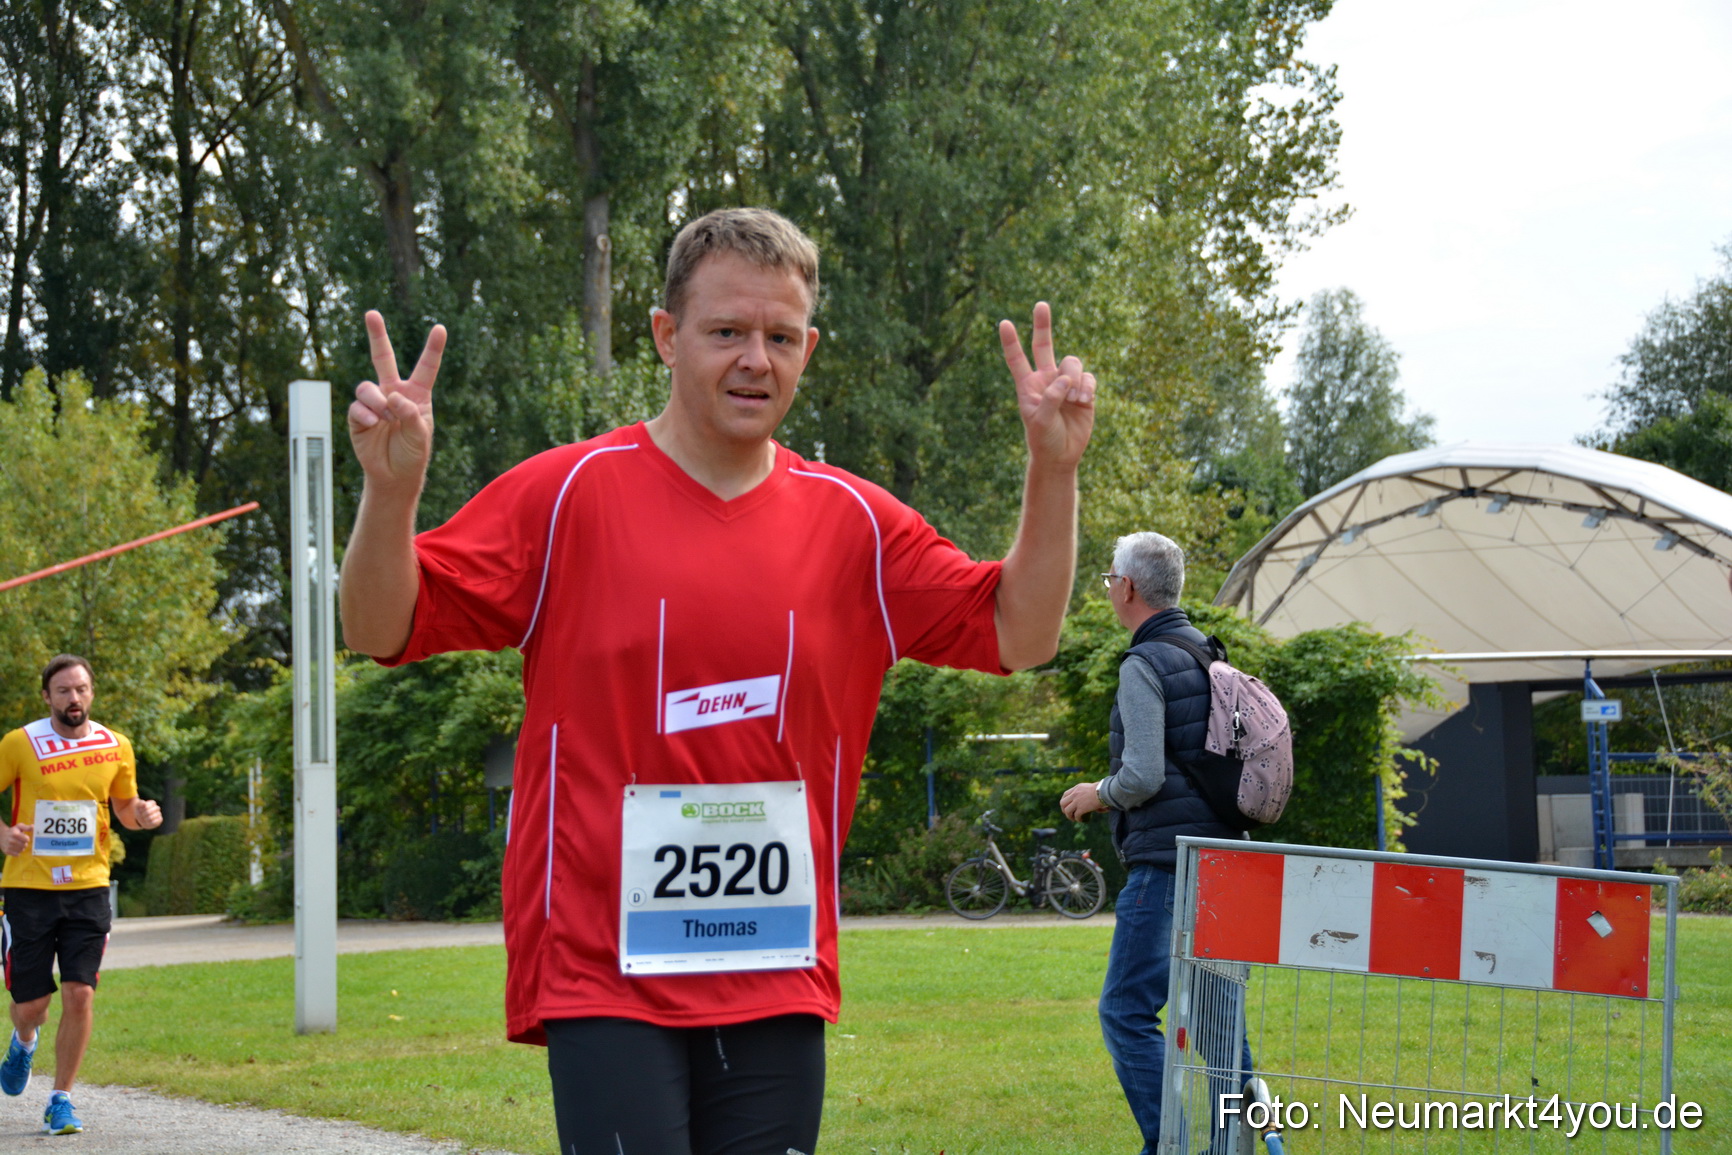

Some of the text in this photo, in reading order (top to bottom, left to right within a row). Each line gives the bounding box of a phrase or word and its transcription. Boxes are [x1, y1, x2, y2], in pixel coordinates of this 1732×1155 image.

[696, 691, 748, 716] DEHN
[40, 753, 121, 776] MAX BÖGL
[702, 801, 766, 818] BOCK
[43, 817, 87, 834] 2636
[652, 841, 790, 898] 2520
[632, 892, 641, 903] D
[682, 918, 758, 938] Thomas
